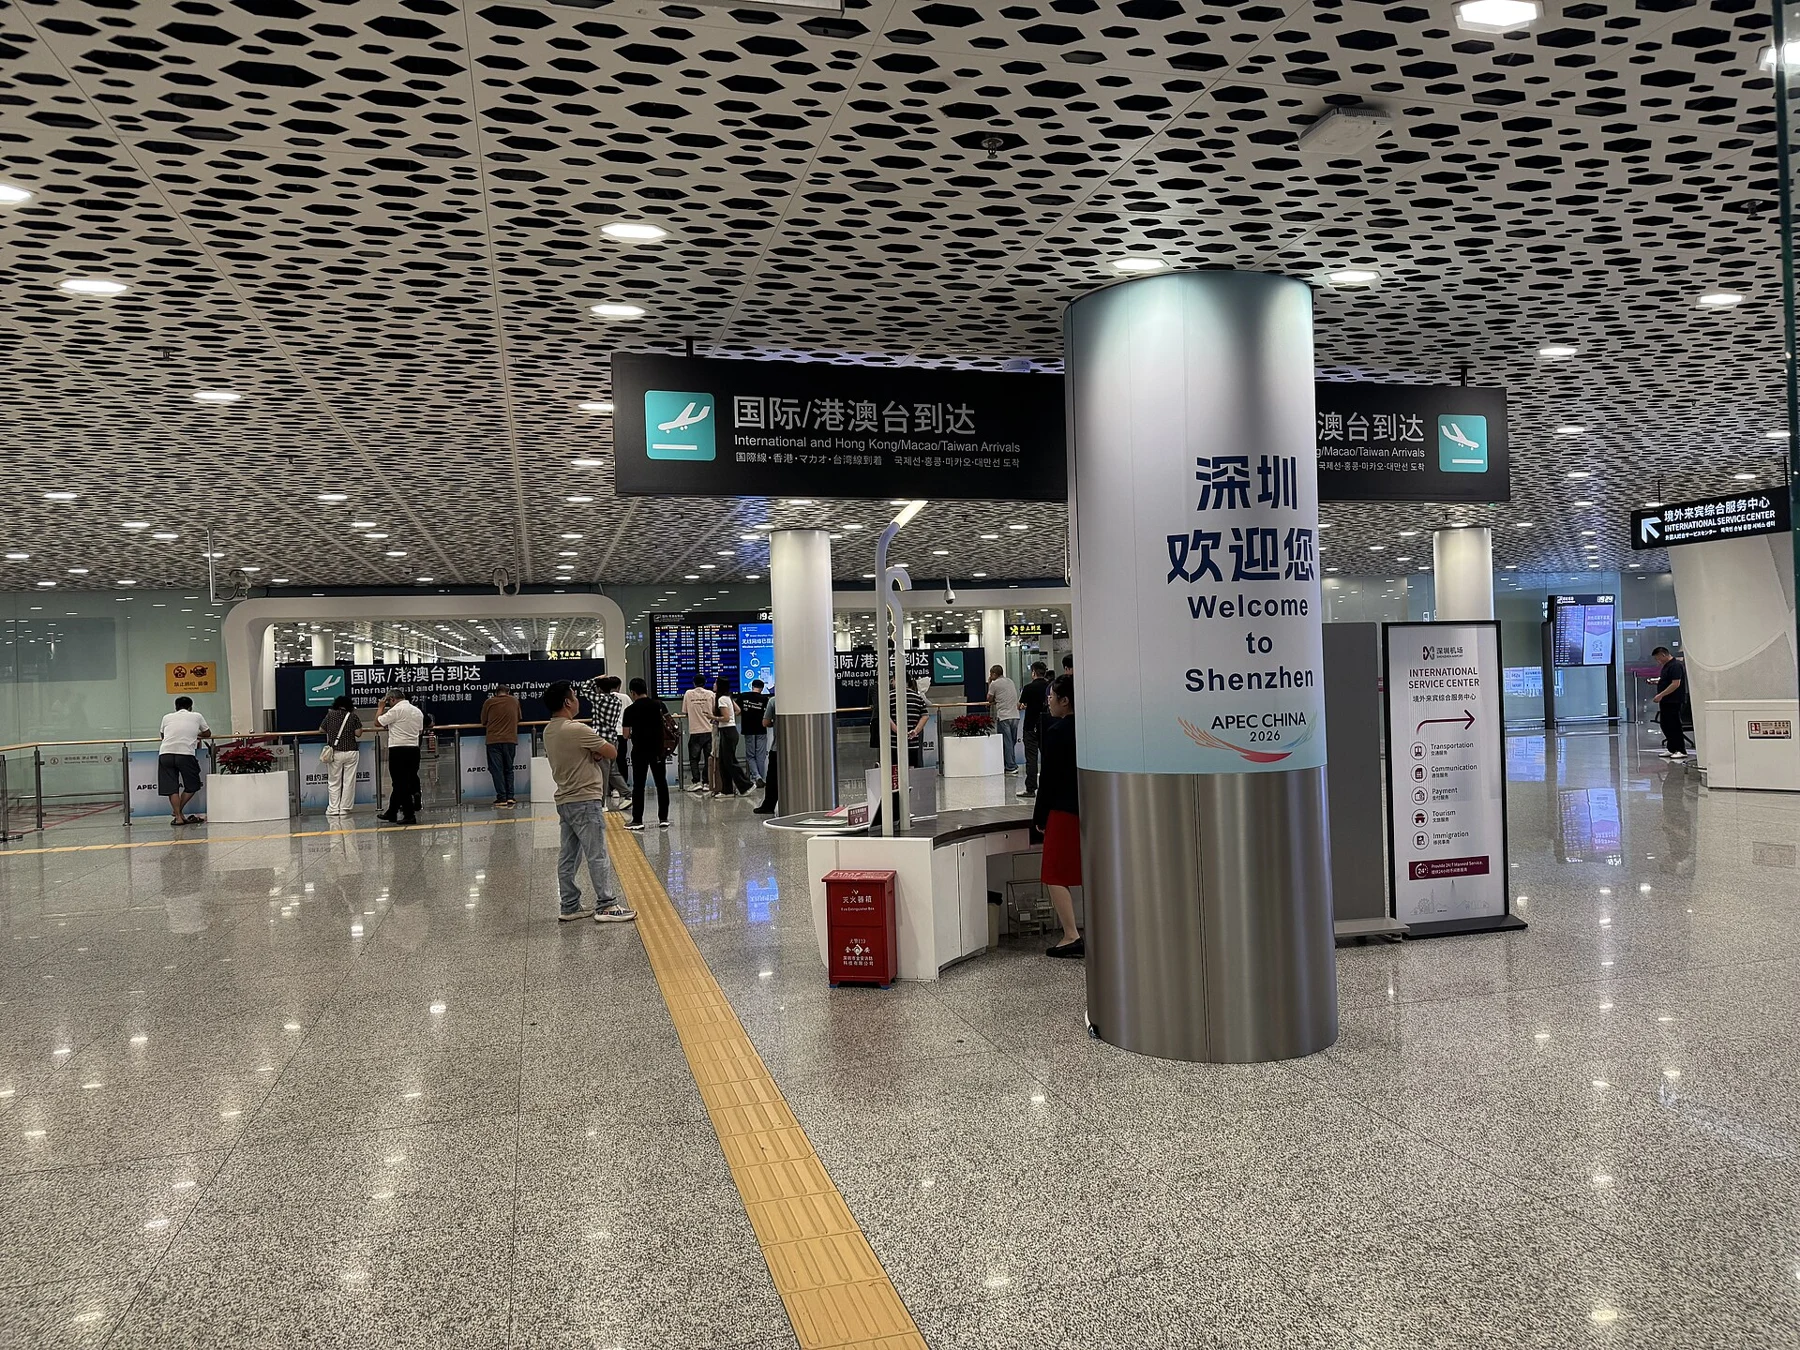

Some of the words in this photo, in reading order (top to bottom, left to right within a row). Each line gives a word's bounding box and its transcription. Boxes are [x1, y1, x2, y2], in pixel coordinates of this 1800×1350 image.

[733, 395, 976, 435] 国际/港澳台到达
[1317, 411, 1425, 442] 澳台到达
[734, 434, 807, 448] International
[810, 437, 832, 448] and
[835, 437, 866, 452] Hong
[868, 439, 979, 453] Kong/Macao/Taiwan
[980, 441, 1021, 453] Arrivals
[1391, 447, 1426, 458] Arrivals
[1195, 454, 1298, 512] 深圳
[1663, 496, 1771, 523] 境外来宾综合服务中心
[1664, 518, 1717, 533] INTERNATIONAL
[1717, 514, 1746, 525] SERVICE
[1745, 509, 1776, 522] CENTER
[1166, 526, 1315, 584] 欢迎您
[1187, 593, 1309, 620] Welcome
[1245, 631, 1273, 655] to
[1409, 666, 1479, 678] INTERNATIONAL
[1184, 665, 1314, 692] Shenzhen
[1408, 679, 1445, 690] SERVICE
[1446, 678, 1480, 688] CENTER
[435, 682, 461, 693] Hong
[1210, 713, 1259, 730] APEC
[1261, 711, 1307, 729] CHINA
[1249, 730, 1281, 742] 2026
[1430, 741, 1474, 751] Transportation
[1430, 763, 1478, 773] Communication
[136, 783, 158, 791] APEC
[1431, 787, 1458, 796] Payment
[1432, 809, 1456, 818] Tourism
[1432, 830, 1469, 840] Immigration
[842, 895, 872, 904] 灭火器箱
